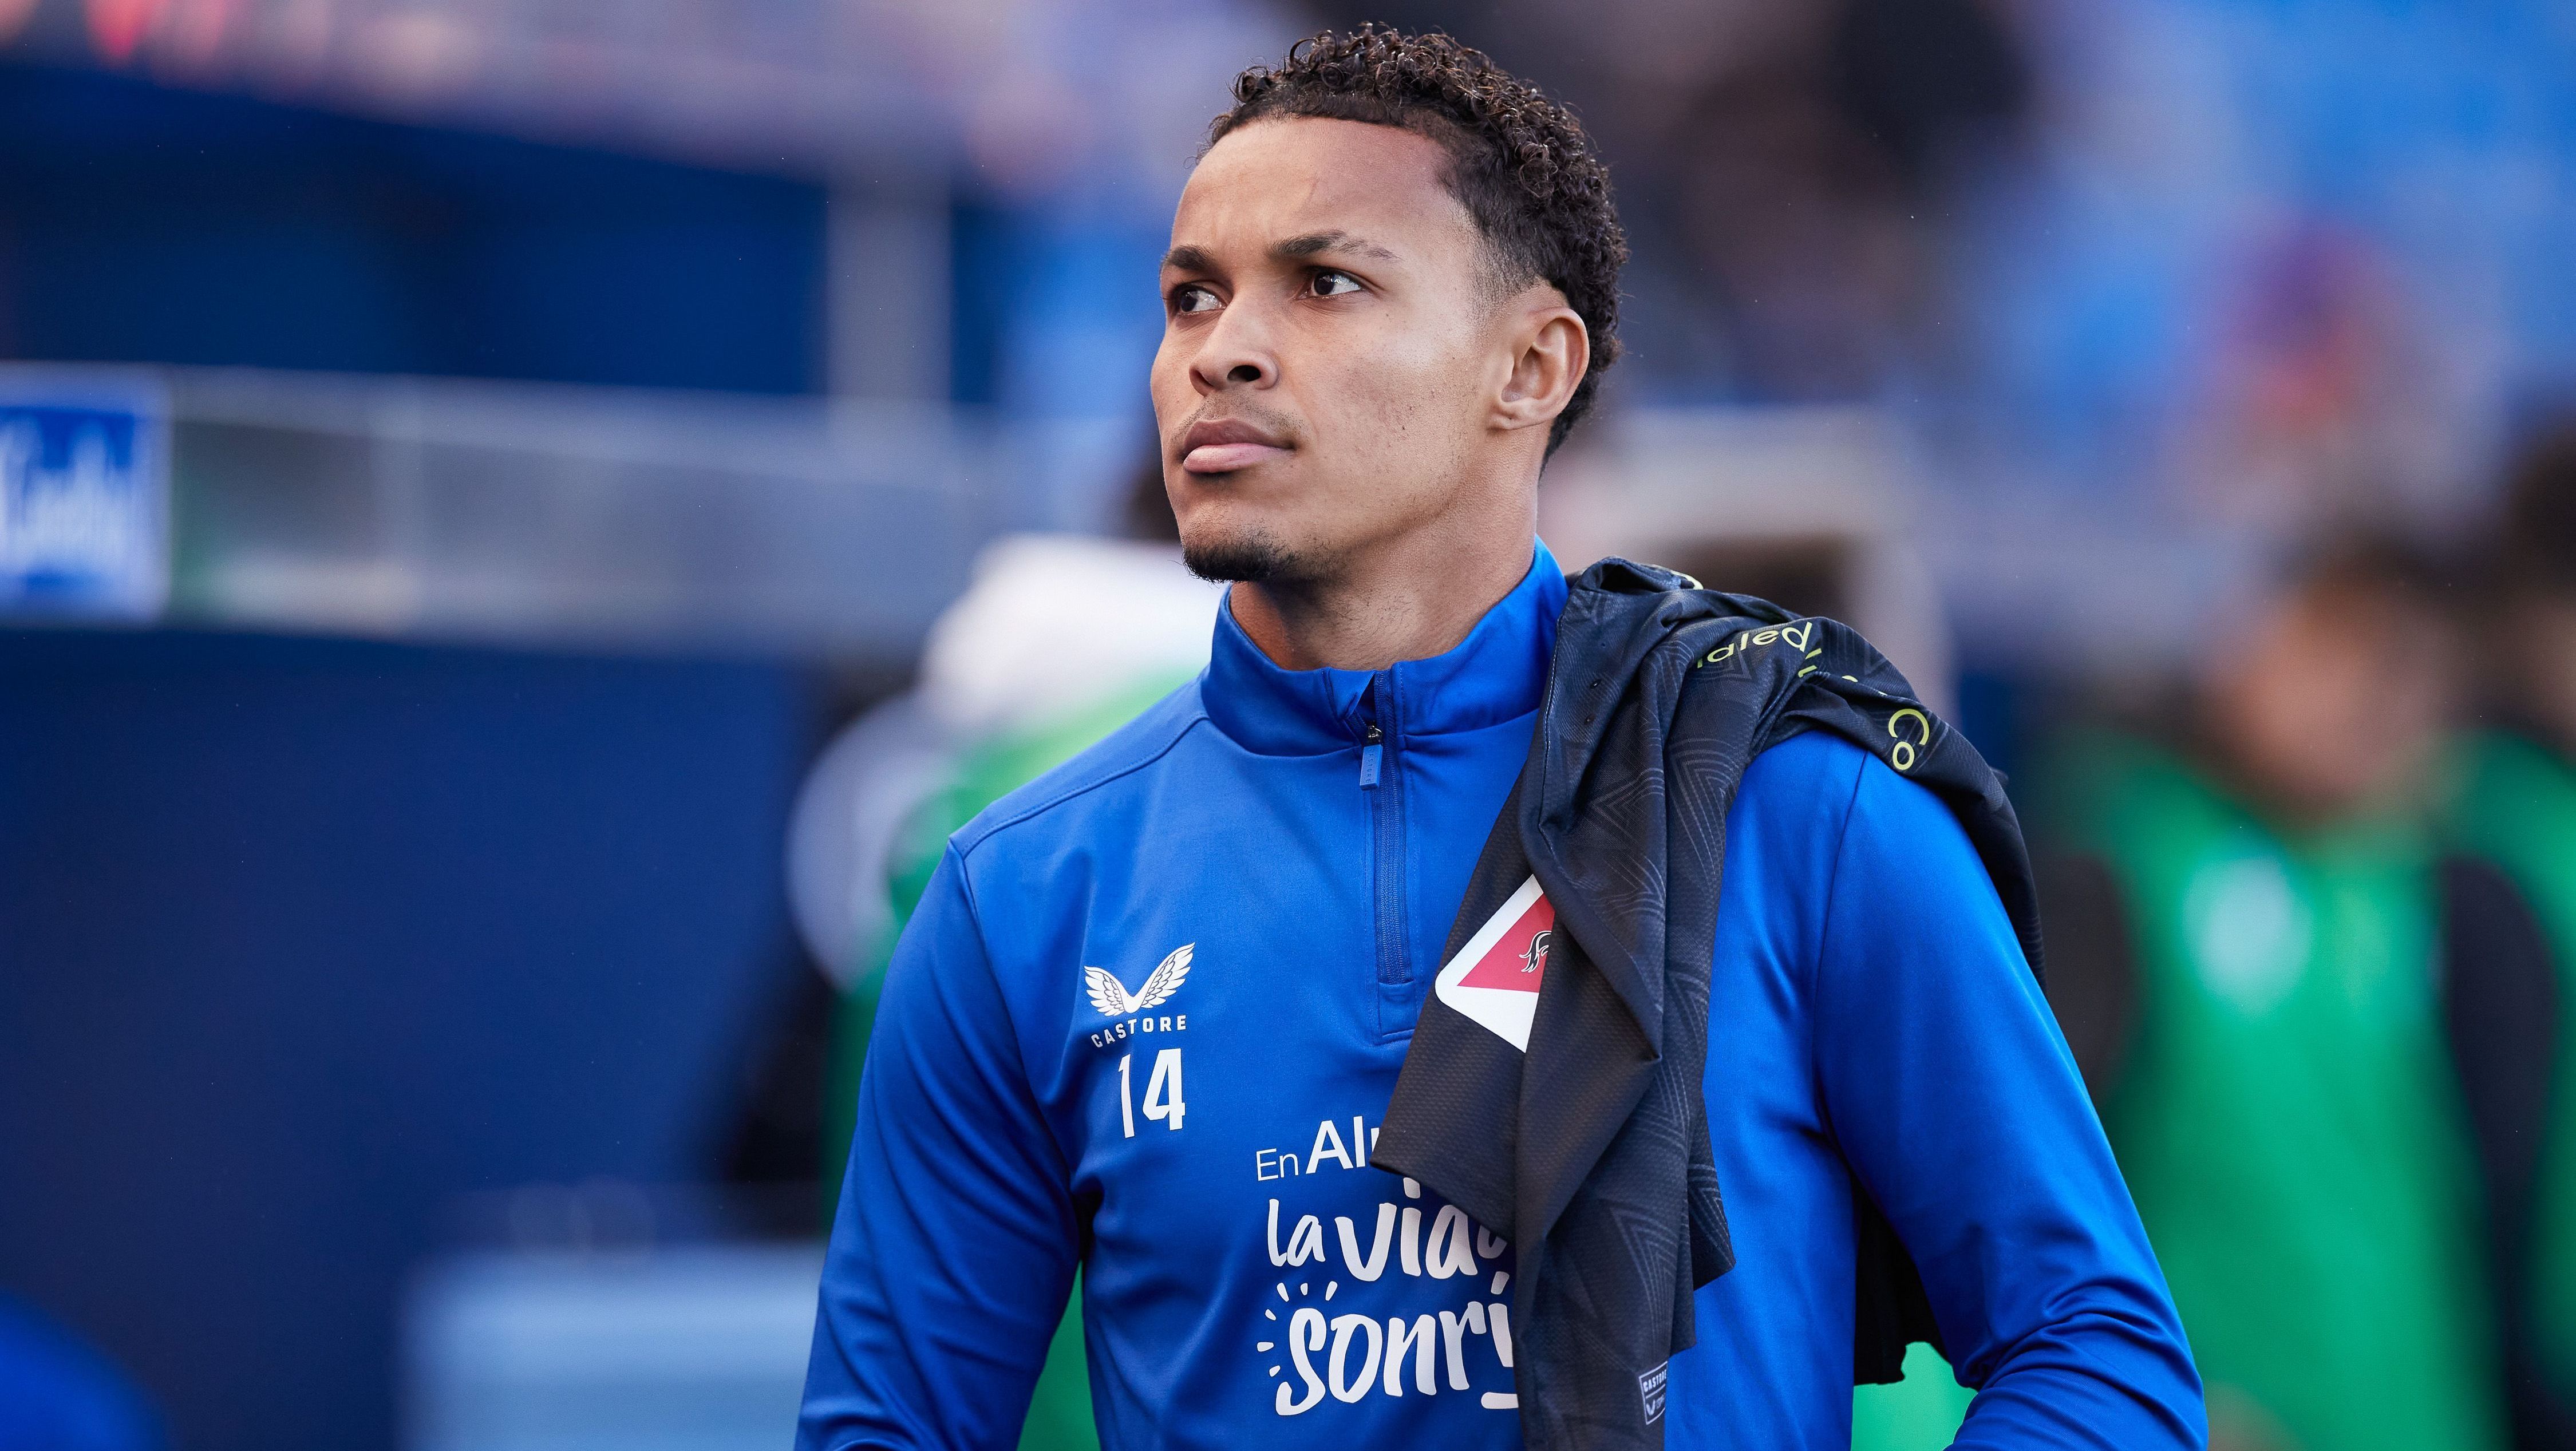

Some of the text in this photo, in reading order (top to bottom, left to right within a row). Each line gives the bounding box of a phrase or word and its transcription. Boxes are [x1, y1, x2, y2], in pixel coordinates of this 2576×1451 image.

[1091, 1015, 1187, 1048] CASTORE
[1118, 1048, 1186, 1138] 14
[1256, 1148, 1299, 1181] En
[1267, 1199, 1326, 1267] la
